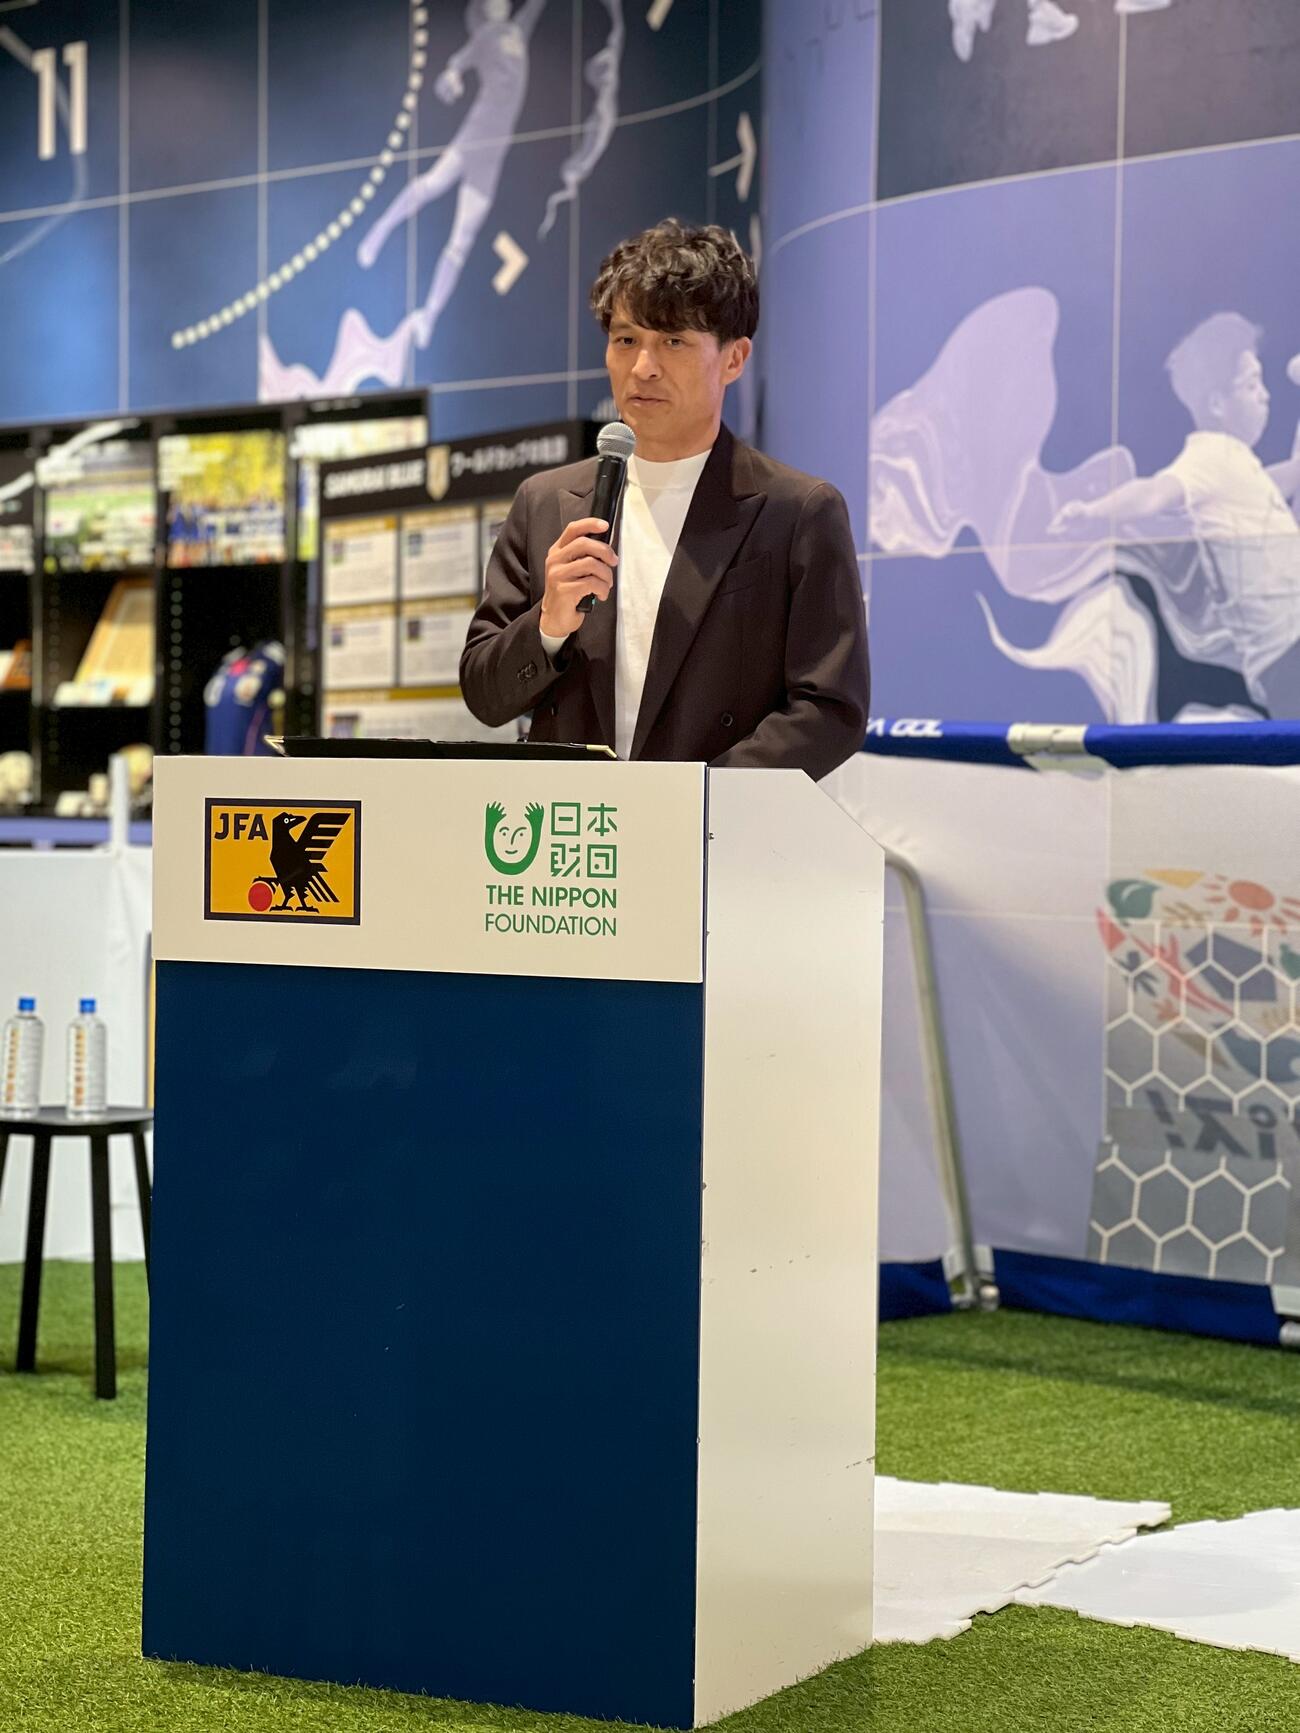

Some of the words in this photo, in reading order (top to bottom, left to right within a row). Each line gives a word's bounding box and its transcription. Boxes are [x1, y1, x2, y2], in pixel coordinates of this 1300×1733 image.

[214, 812, 269, 841] JFA
[550, 801, 617, 837] 日本
[550, 843, 617, 878] 財団
[485, 884, 524, 906] THE
[531, 886, 617, 909] NIPPON
[485, 913, 617, 937] FOUNDATION
